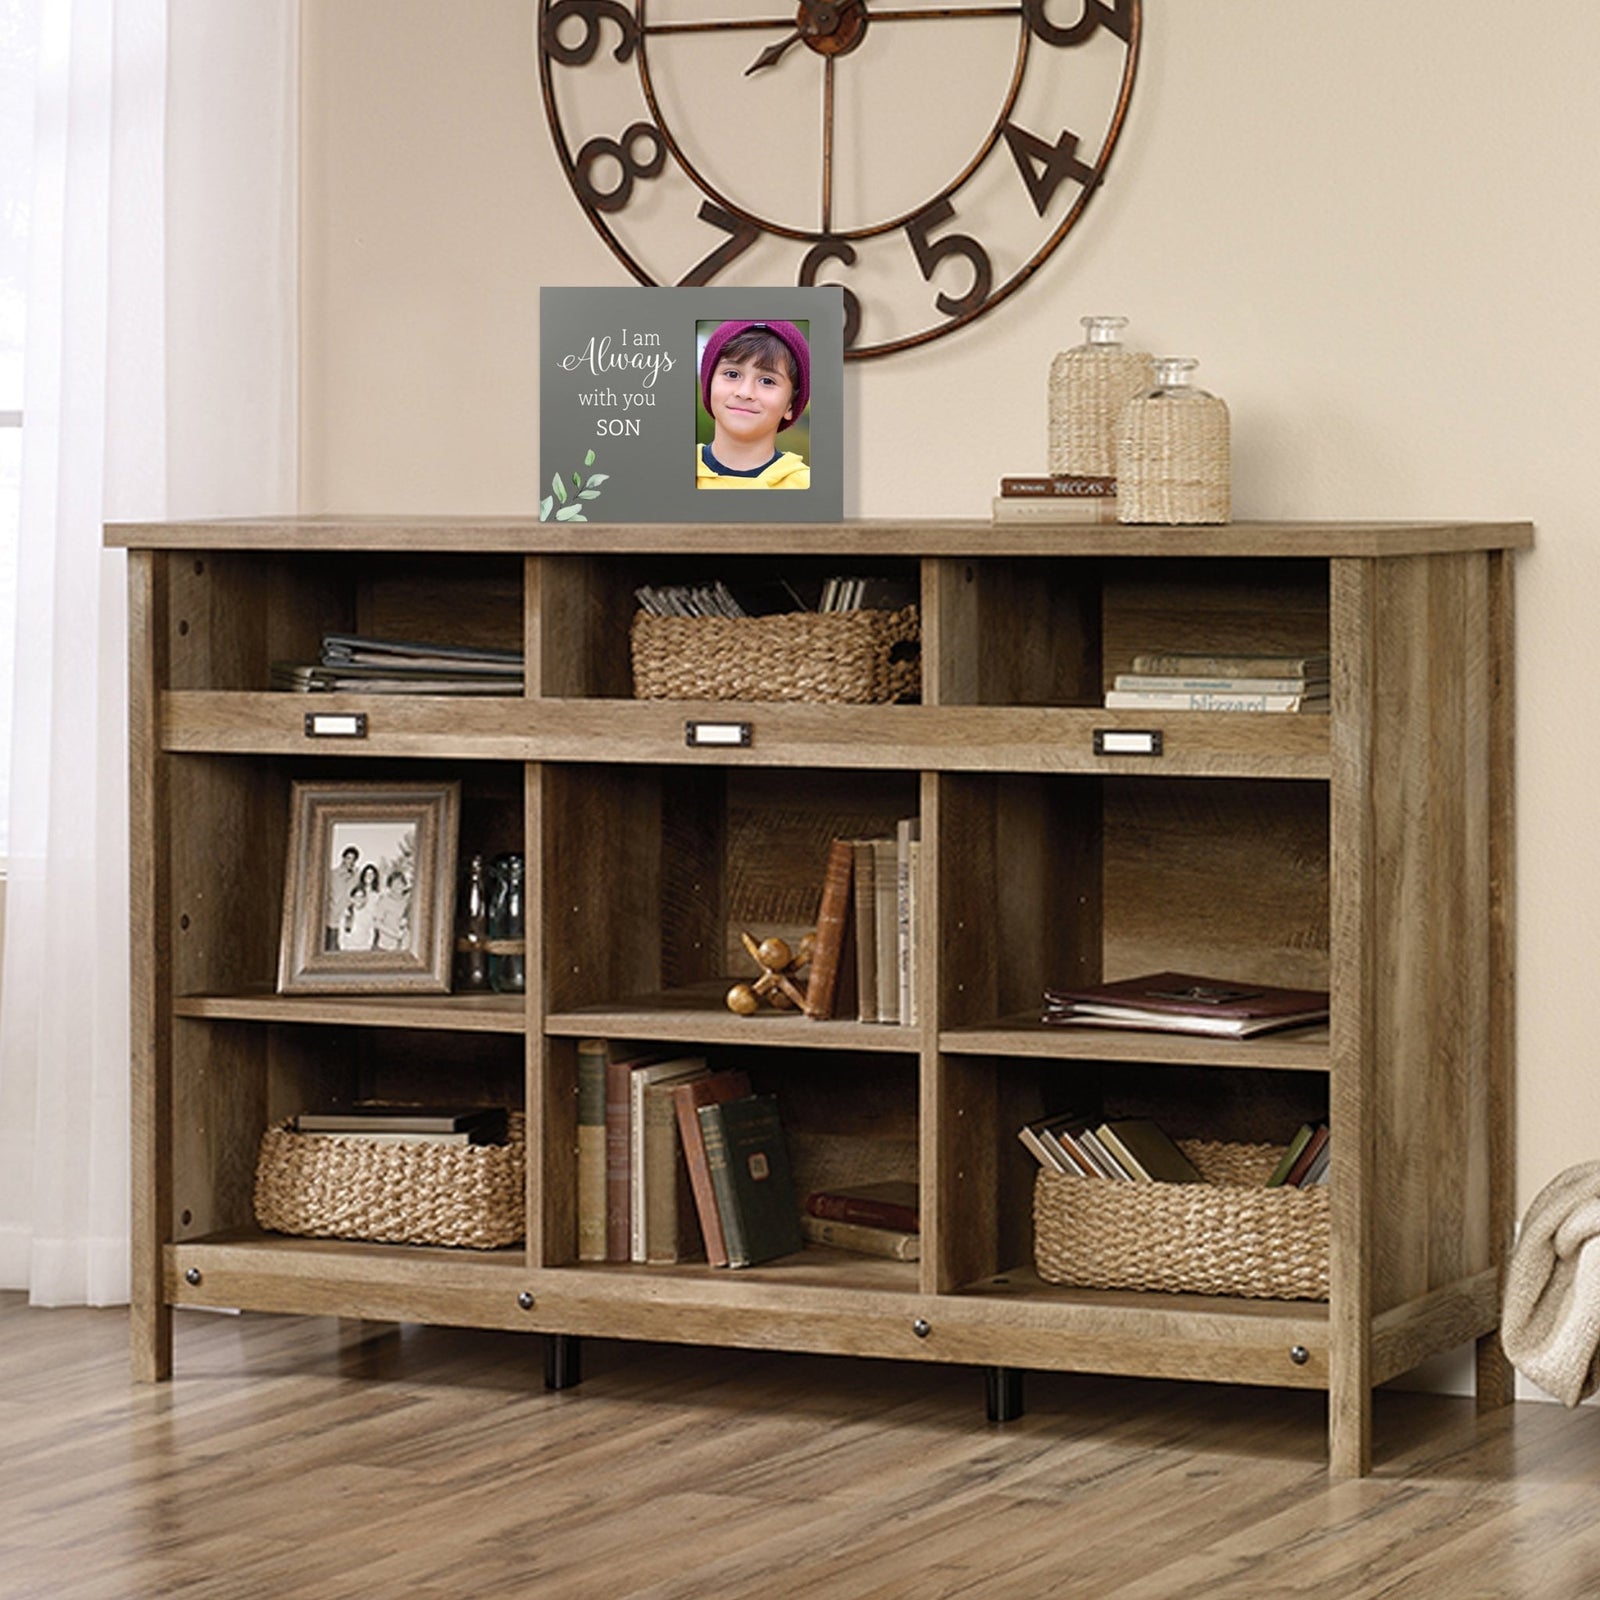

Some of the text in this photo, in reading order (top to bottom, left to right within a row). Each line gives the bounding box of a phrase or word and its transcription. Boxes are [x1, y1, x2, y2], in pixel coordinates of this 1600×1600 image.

[546, 0, 639, 67] 9
[574, 122, 667, 214] 8
[1001, 121, 1100, 217] 4
[676, 200, 761, 287] 7
[905, 200, 992, 316] 5
[556, 336, 676, 389] Always
[622, 329, 660, 346] I am
[578, 387, 656, 411] with you
[596, 419, 641, 436] SON
